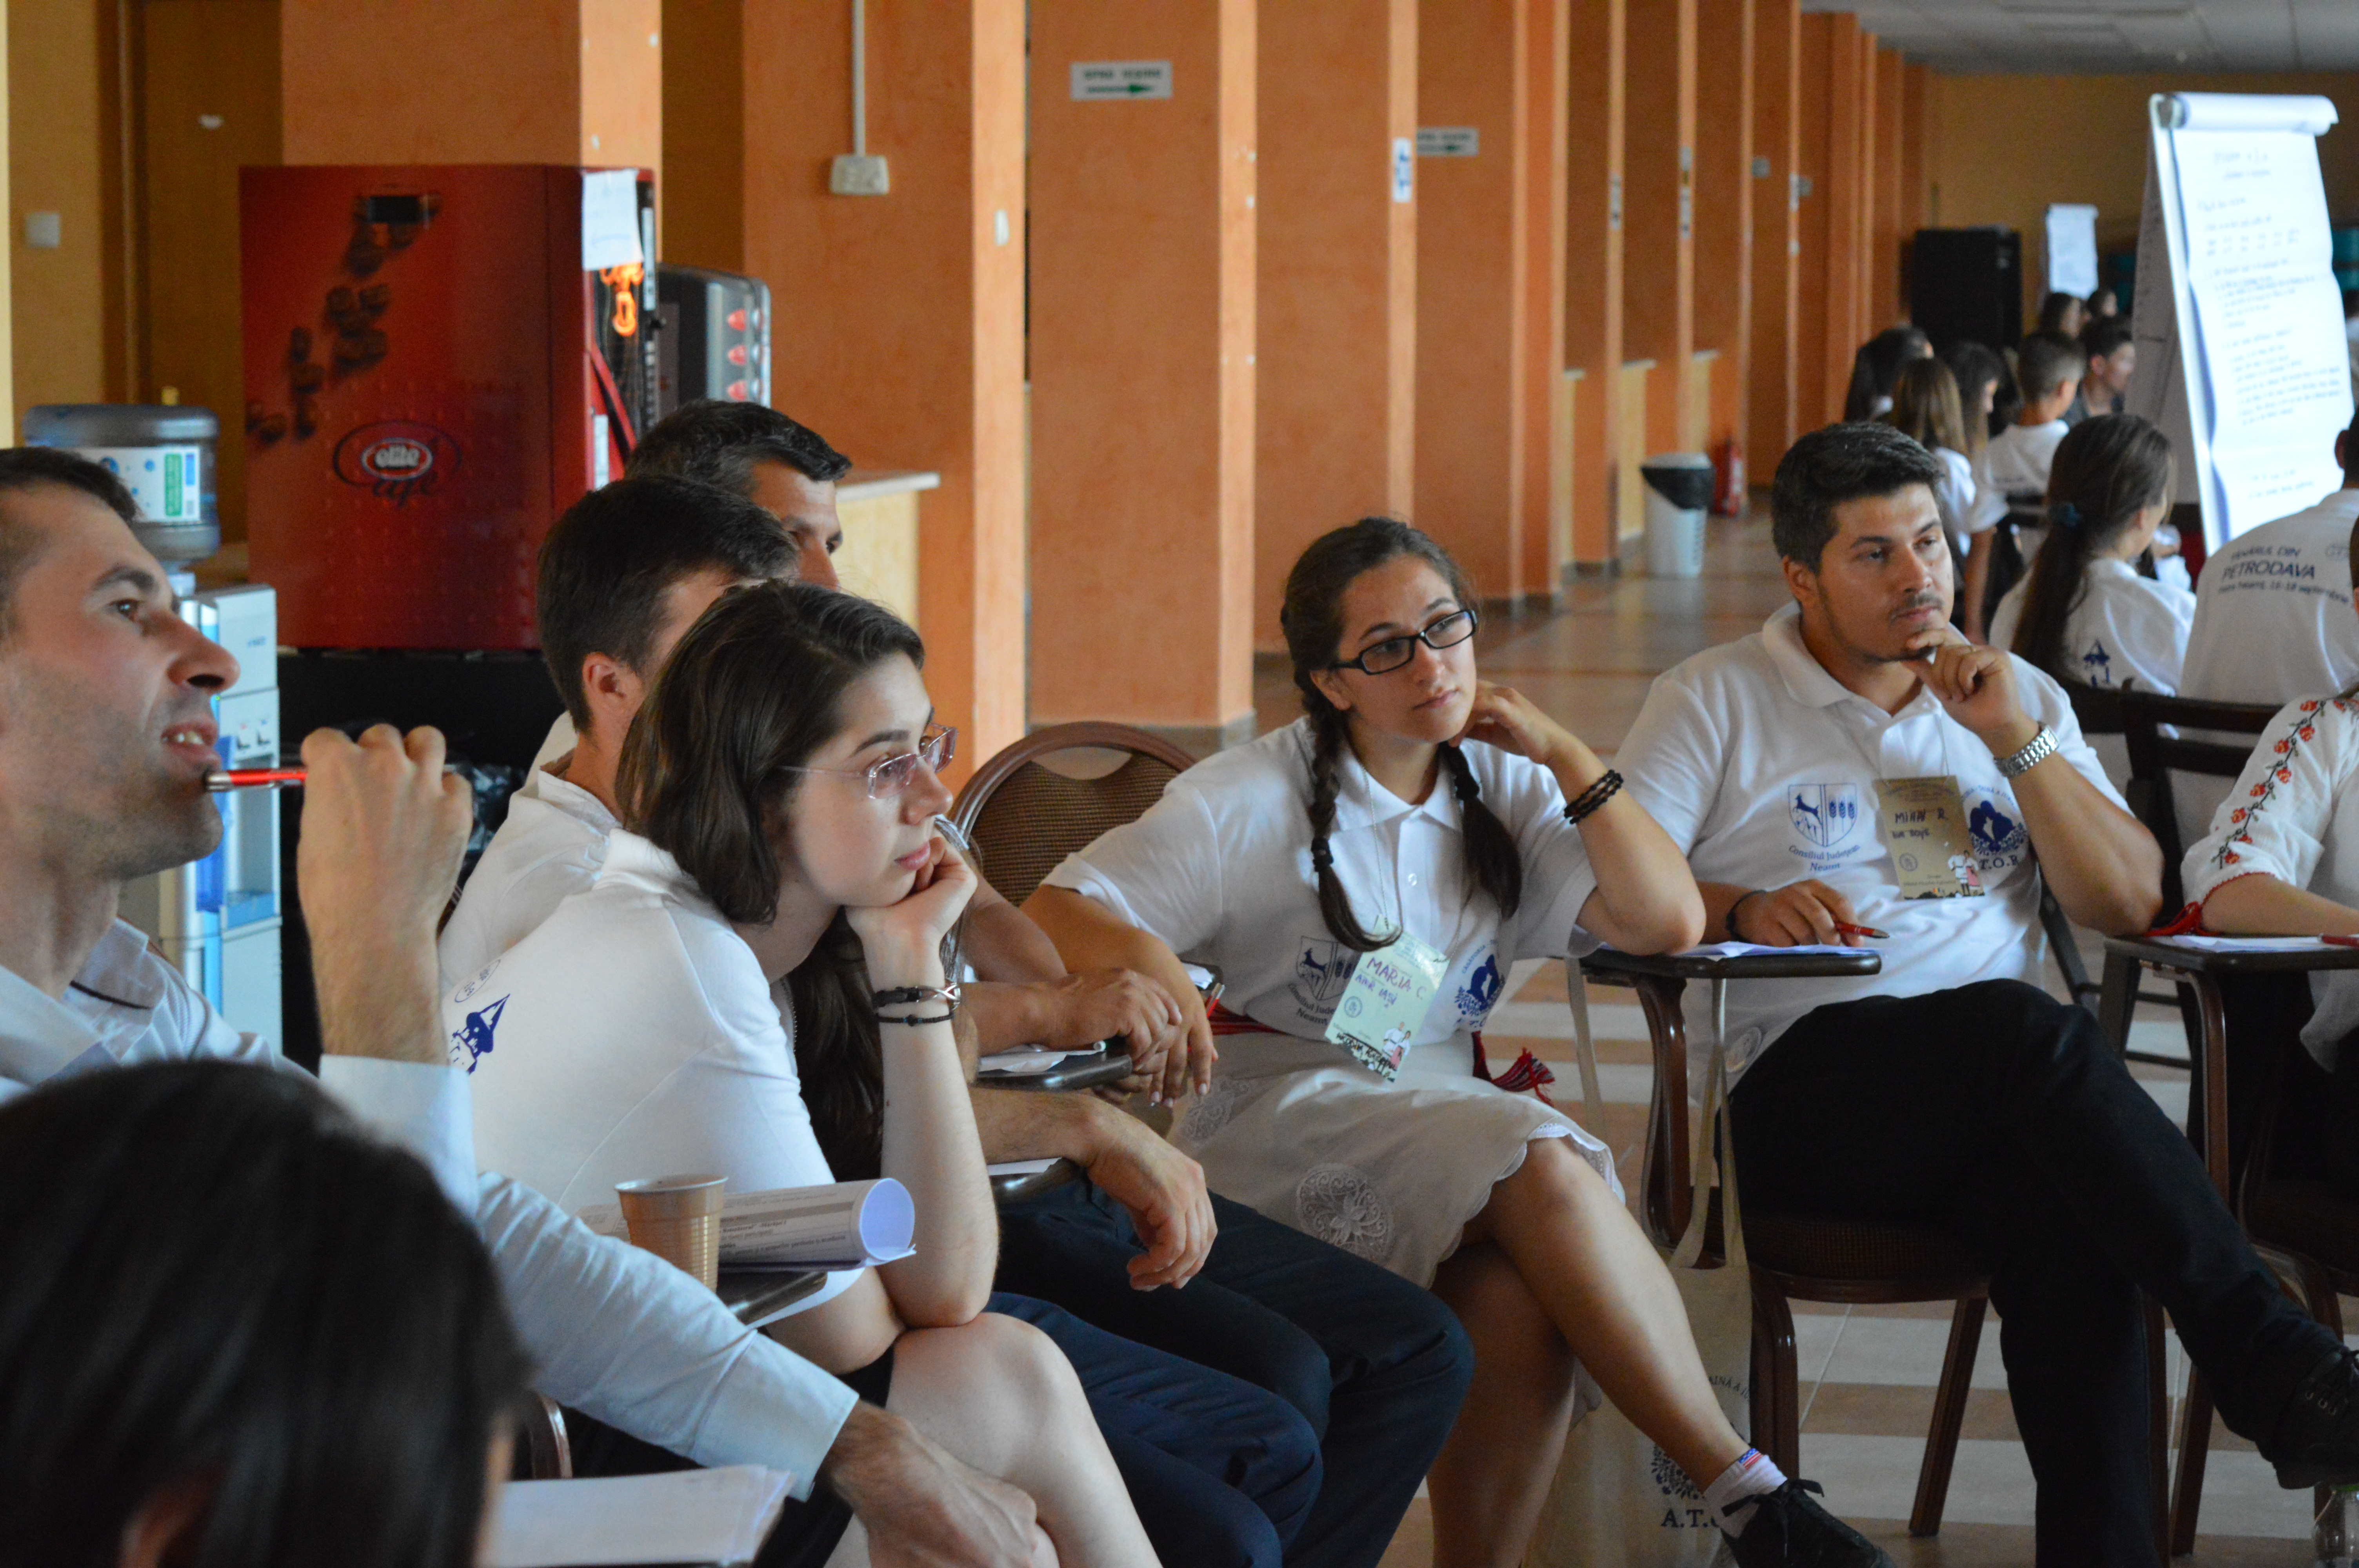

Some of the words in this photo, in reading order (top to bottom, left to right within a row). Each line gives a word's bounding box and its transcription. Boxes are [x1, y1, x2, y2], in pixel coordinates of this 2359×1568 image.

[2221, 560, 2315, 582] PETRODAVA
[1788, 845, 1824, 860] Consiliul
[1366, 957, 1412, 992] MARIA
[1316, 1005, 1336, 1015] Jude
